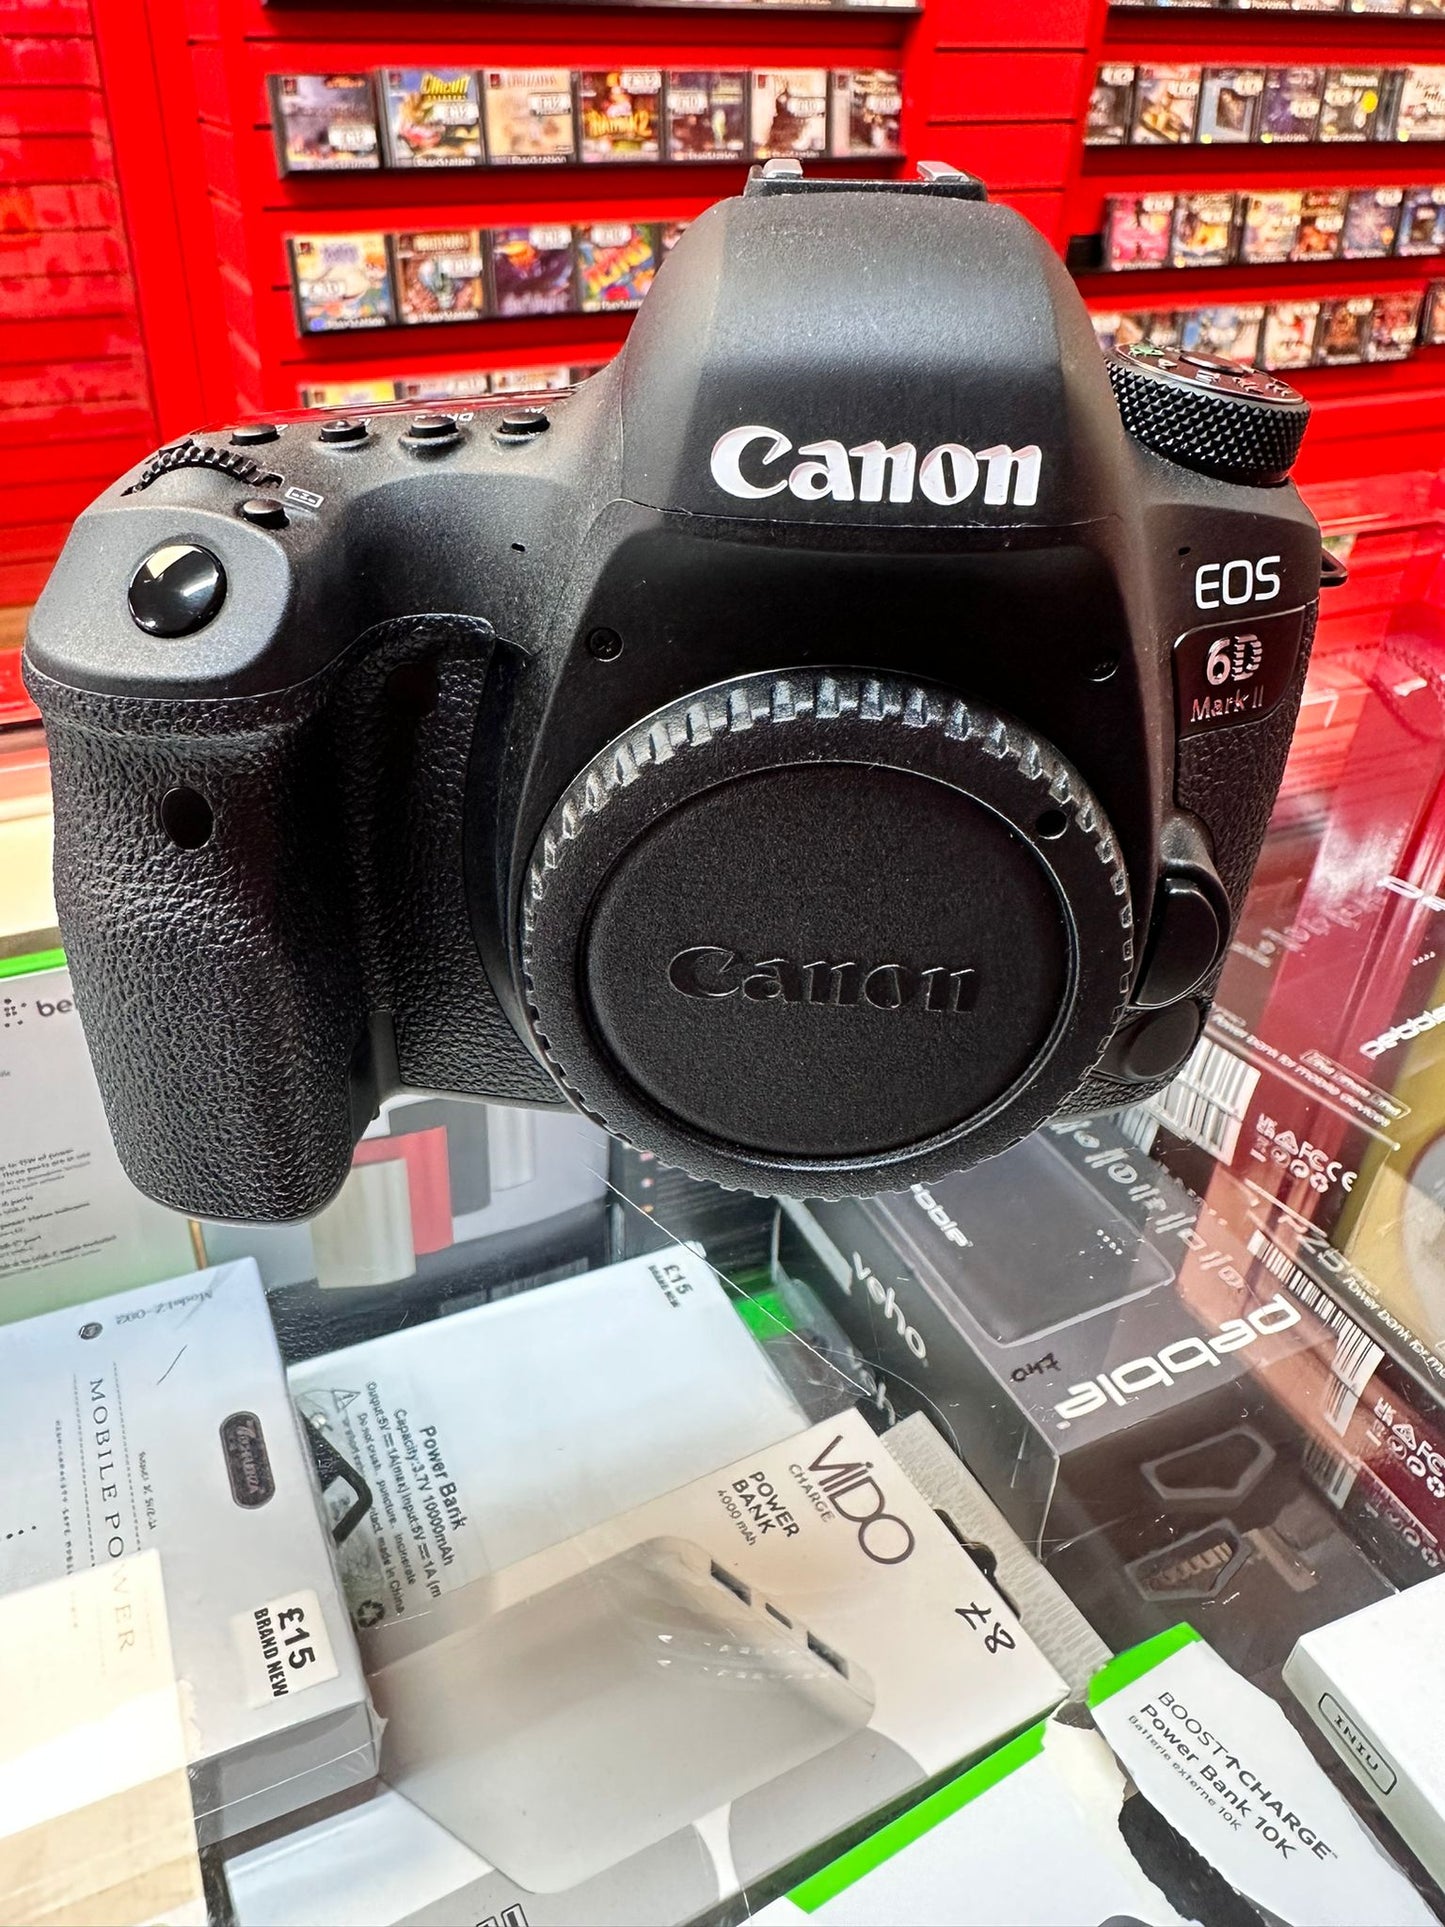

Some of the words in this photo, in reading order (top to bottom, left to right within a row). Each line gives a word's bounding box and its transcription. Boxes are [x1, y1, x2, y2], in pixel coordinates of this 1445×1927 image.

[710, 425, 1043, 507] Canon
[1195, 555, 1281, 610] EOS
[1206, 633, 1264, 686] 6D
[1190, 688, 1250, 723] Mark
[667, 945, 977, 1014] Canon
[662, 1264, 693, 1295] £15
[1054, 1292, 1301, 1420] pebble
[1376, 1309, 1413, 1343] bank
[420, 1425, 449, 1479] Power
[440, 1481, 468, 1531] Bank
[731, 1478, 777, 1535] BANK
[748, 1471, 800, 1538] POWER
[788, 1463, 836, 1524] CHARGE
[89, 1378, 118, 1503] MOBILE
[104, 1511, 136, 1652] POWER
[717, 1489, 743, 1520] 4000
[736, 1520, 758, 1546] mAh
[254, 1607, 278, 1661] BRAND
[266, 1660, 289, 1698] NEW
[277, 1606, 317, 1671] £15
[1127, 1714, 1173, 1761] Batterie
[1172, 1761, 1217, 1808] externe
[1217, 1806, 1243, 1832] 10K
[1334, 1714, 1379, 1771] INIU
[1140, 1703, 1200, 1763] Power
[1199, 1764, 1252, 1819] Bank
[1254, 1815, 1297, 1860] 10K
